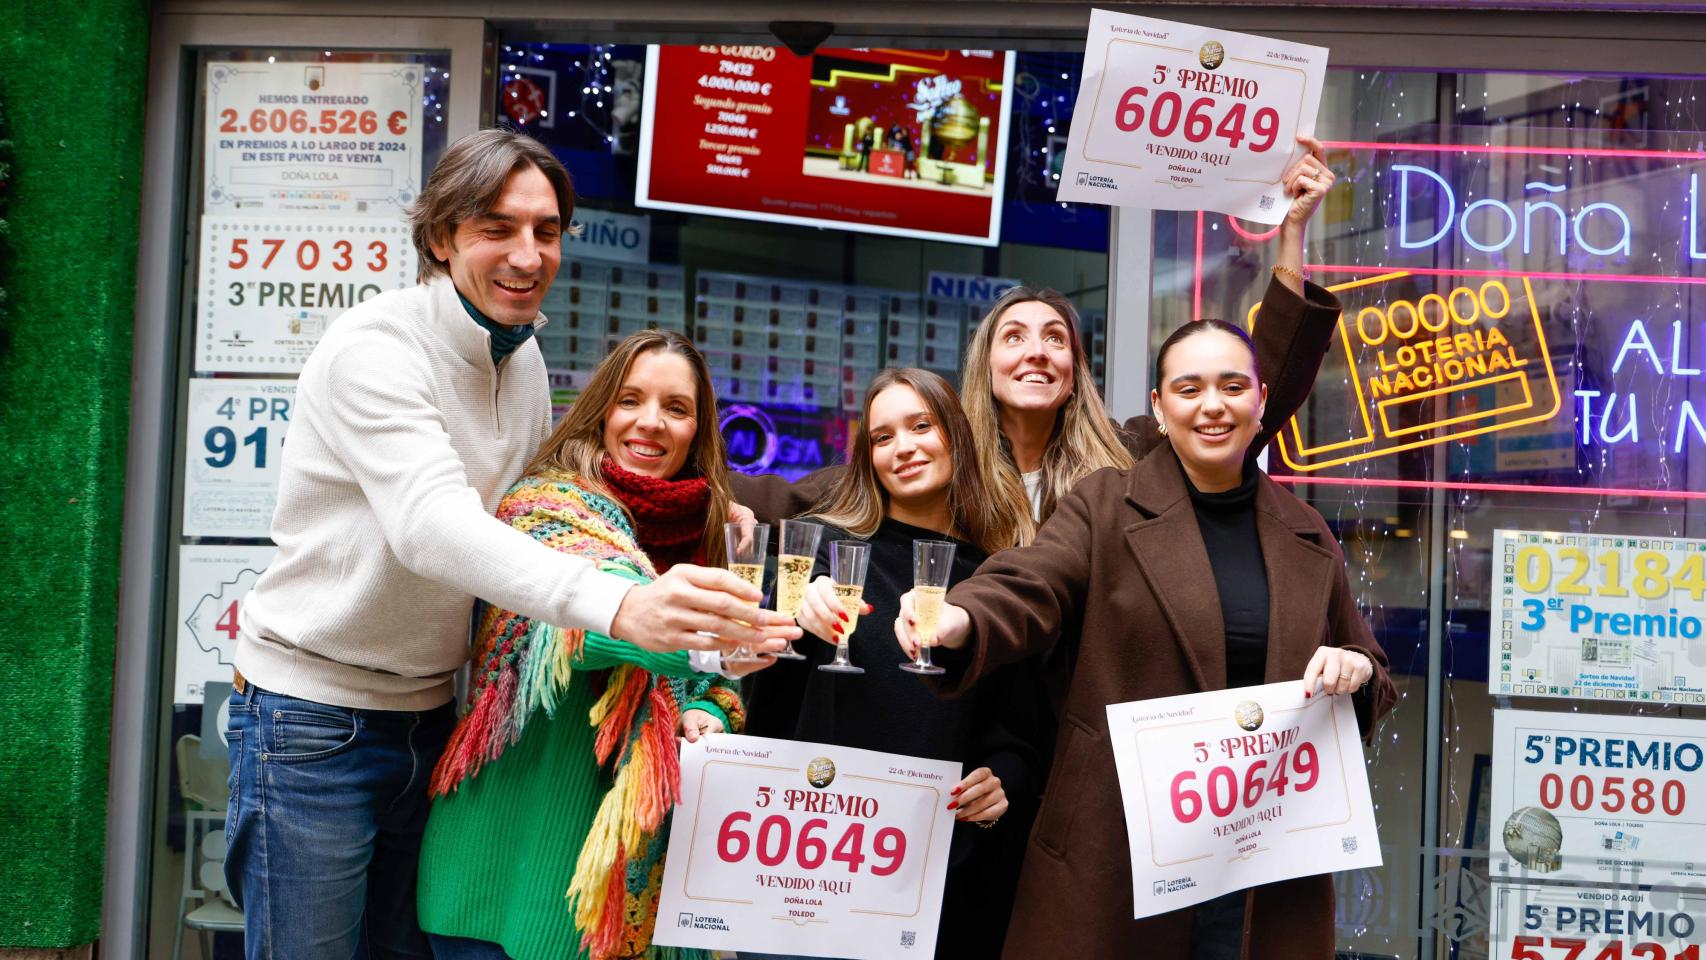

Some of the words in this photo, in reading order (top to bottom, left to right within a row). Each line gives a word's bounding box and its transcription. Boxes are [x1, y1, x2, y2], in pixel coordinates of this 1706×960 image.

[761, 82, 772, 96] €
[1176, 68, 1258, 100] PREMIO
[259, 95, 298, 104] HEMOS
[302, 96, 368, 105] ENTREGADO
[220, 108, 378, 134] 2.606.526
[386, 111, 408, 135] €
[1115, 86, 1280, 152] 60649
[220, 140, 234, 149] EN
[238, 140, 288, 150] PREMIOS
[291, 140, 298, 150] A
[301, 141, 316, 150] LO
[319, 142, 356, 150] LARGO
[360, 142, 374, 151] DE
[378, 142, 406, 152] 2024
[1146, 143, 1198, 162] VENDIDO
[1200, 151, 1231, 166] AQUÍ
[242, 152, 256, 162] EN
[260, 152, 286, 162] ESTE
[288, 153, 325, 163] PUNTO
[328, 154, 343, 162] DE
[346, 154, 382, 164] VENTA
[1168, 163, 1187, 173] DOÑA
[1188, 166, 1202, 174] LOLA
[282, 169, 310, 181] DOÑA
[313, 171, 338, 181] LOLA
[1088, 181, 1118, 190] NACIONAL
[1090, 174, 1114, 184] LOTERÍA
[1170, 175, 1194, 184] TOLEDO
[1391, 164, 1631, 256] Doña
[228, 238, 388, 272] 57033
[1377, 326, 1508, 374] LOTERIA
[1370, 351, 1528, 399] NACIONAL
[249, 398, 296, 421] PR
[1574, 390, 1638, 444] TU
[204, 426, 286, 468] 91
[1516, 546, 1706, 602] 02184
[1570, 604, 1702, 640] Premio
[1220, 726, 1300, 760] PREMIO
[1524, 734, 1552, 764] 5º
[1554, 736, 1704, 772] PREMIO
[1170, 741, 1320, 824] 60649
[784, 788, 879, 819] PREMIO
[1540, 773, 1686, 816] 00580
[1214, 814, 1254, 838] VENDIDO
[1257, 803, 1282, 822] AQUÍ
[716, 811, 907, 877] 60649
[1248, 830, 1262, 839] LOLA
[755, 874, 814, 891] VENDIDO
[818, 878, 852, 896] AQUÍ
[1166, 876, 1192, 886] LOTERÍA
[1166, 881, 1197, 894] NACIONAL
[784, 896, 804, 906] DOÑA
[805, 897, 822, 906] LOLA
[1577, 892, 1619, 902] VENDIDO
[1622, 894, 1644, 903] AQUÍ
[694, 914, 724, 924] LOTERÍA
[788, 910, 815, 918] TOLEDO
[1556, 906, 1695, 938] PREMIO
[694, 922, 730, 932] NACIONAL
